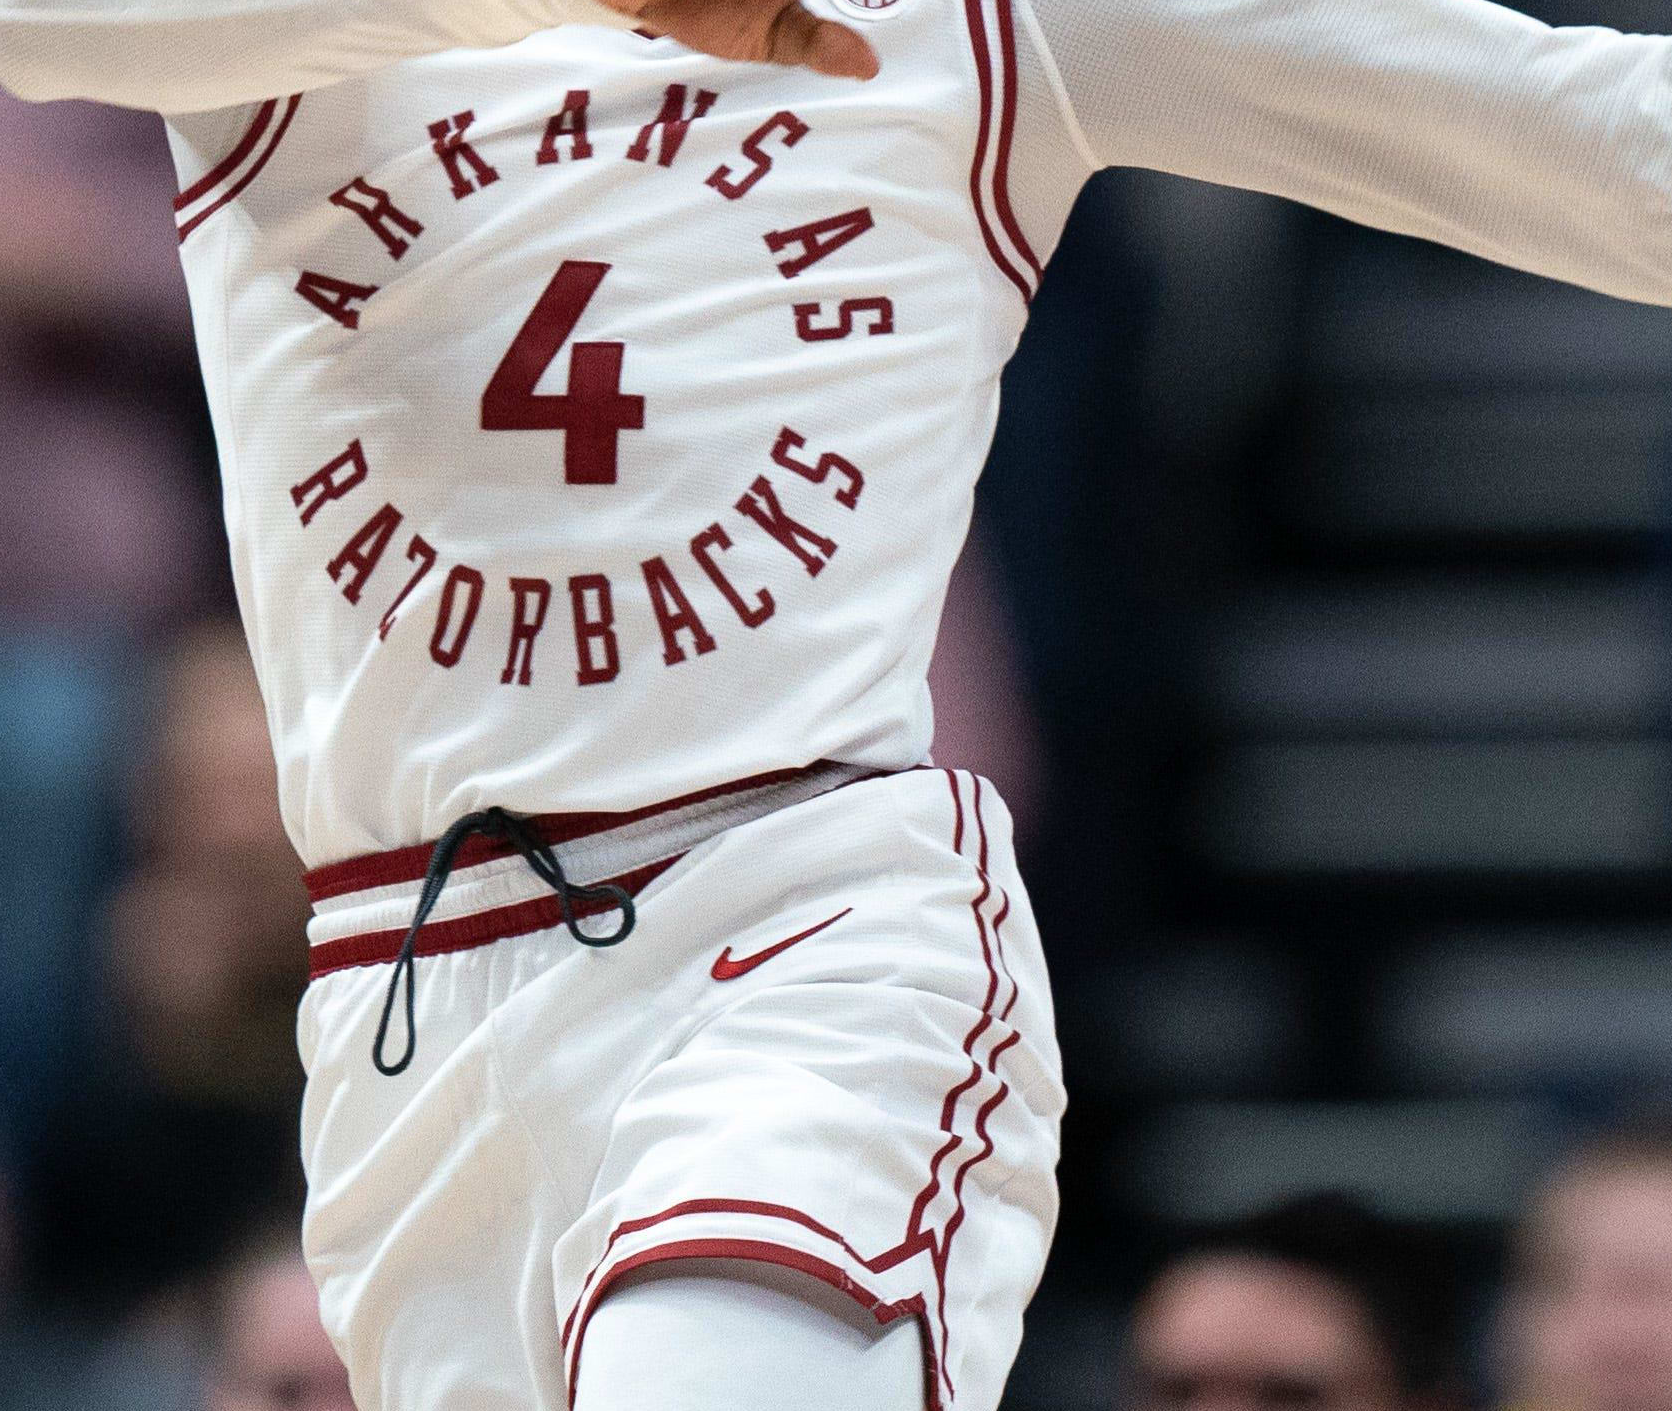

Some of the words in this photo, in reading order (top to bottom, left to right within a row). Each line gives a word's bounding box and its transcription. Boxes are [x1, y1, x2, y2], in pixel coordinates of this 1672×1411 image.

[293, 83, 895, 344] ARKANSAS
[480, 259, 646, 485] 4
[289, 425, 865, 687] RAZORBACKS
